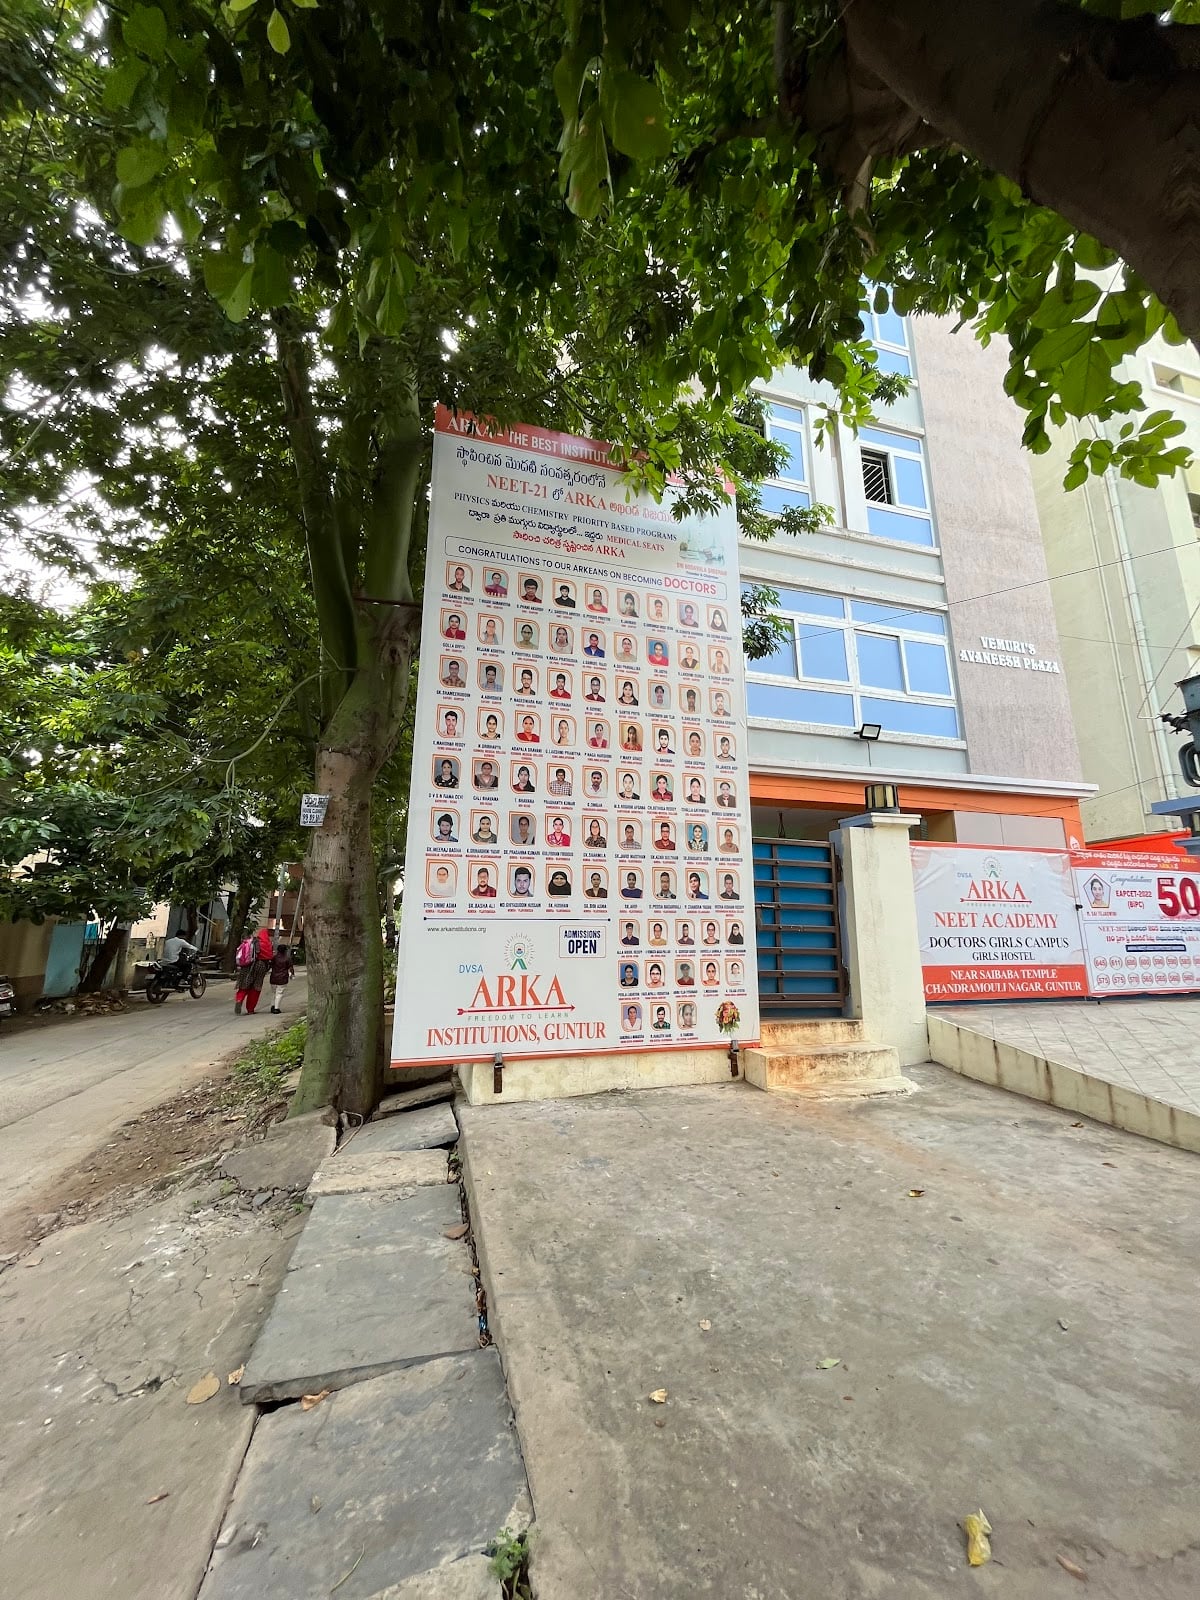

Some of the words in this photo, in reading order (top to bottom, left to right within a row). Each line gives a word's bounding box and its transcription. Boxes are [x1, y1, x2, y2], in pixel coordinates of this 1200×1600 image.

[508, 430, 528, 446] THE
[531, 436, 558, 453] BEST
[456, 445, 502, 467] స్థాపించిన
[505, 455, 536, 474] మొదటి
[540, 463, 606, 488] సంవత్సరంలోనే
[487, 474, 548, 498] NEET-21
[552, 487, 564, 500] లో
[564, 491, 606, 510] ARKA
[454, 492, 490, 506] PHYSICS
[491, 499, 520, 512] మరియు
[521, 505, 569, 520] CHEMISTRY
[572, 515, 610, 528] PRIORITY
[611, 522, 635, 534] BASED
[636, 527, 677, 541] PROGRAMS
[595, 545, 626, 558] ARKA
[606, 534, 642, 548] MEDICAL
[642, 541, 664, 552] SEATS
[458, 545, 540, 566] CONGRATULATIONS
[542, 559, 552, 568] TO
[554, 561, 570, 572] OUR
[573, 564, 608, 578] ARKEANS
[609, 570, 622, 580] ON
[622, 573, 662, 586] BECOMING
[664, 576, 717, 595] DOCTORS
[980, 636, 1036, 656] VEMURI'S
[959, 649, 1022, 668] AVANEESH
[1023, 657, 1060, 674] PLAZA
[967, 879, 1027, 900] ARKA
[1115, 890, 1152, 898] EAPCET-2022
[1156, 877, 1200, 917] 50
[933, 911, 978, 928] NEET
[982, 912, 1058, 929] ACADEMY
[563, 929, 600, 940] ADMISSIONS
[929, 936, 986, 948] DOCTORS
[988, 936, 1023, 948] GIRLS
[1024, 936, 1069, 948] CAMPUS
[568, 939, 597, 954] OPEN
[972, 951, 999, 961] GIRLS
[1000, 951, 1035, 961] HOSTEL
[458, 964, 484, 974] DVSA
[950, 969, 978, 980] NEAR
[979, 969, 1020, 980] SAIBABA
[1020, 969, 1058, 979] TEMPLE
[470, 973, 568, 1008] ARKA
[925, 982, 1007, 994] CHANDRAMOULI
[1008, 982, 1044, 993] NAGAR,
[1044, 981, 1082, 992] GUNTUR
[467, 1014, 515, 1022] FREEDOM
[427, 1022, 541, 1047] INSTITUTIONS,
[543, 1021, 606, 1041] GUNTUR
